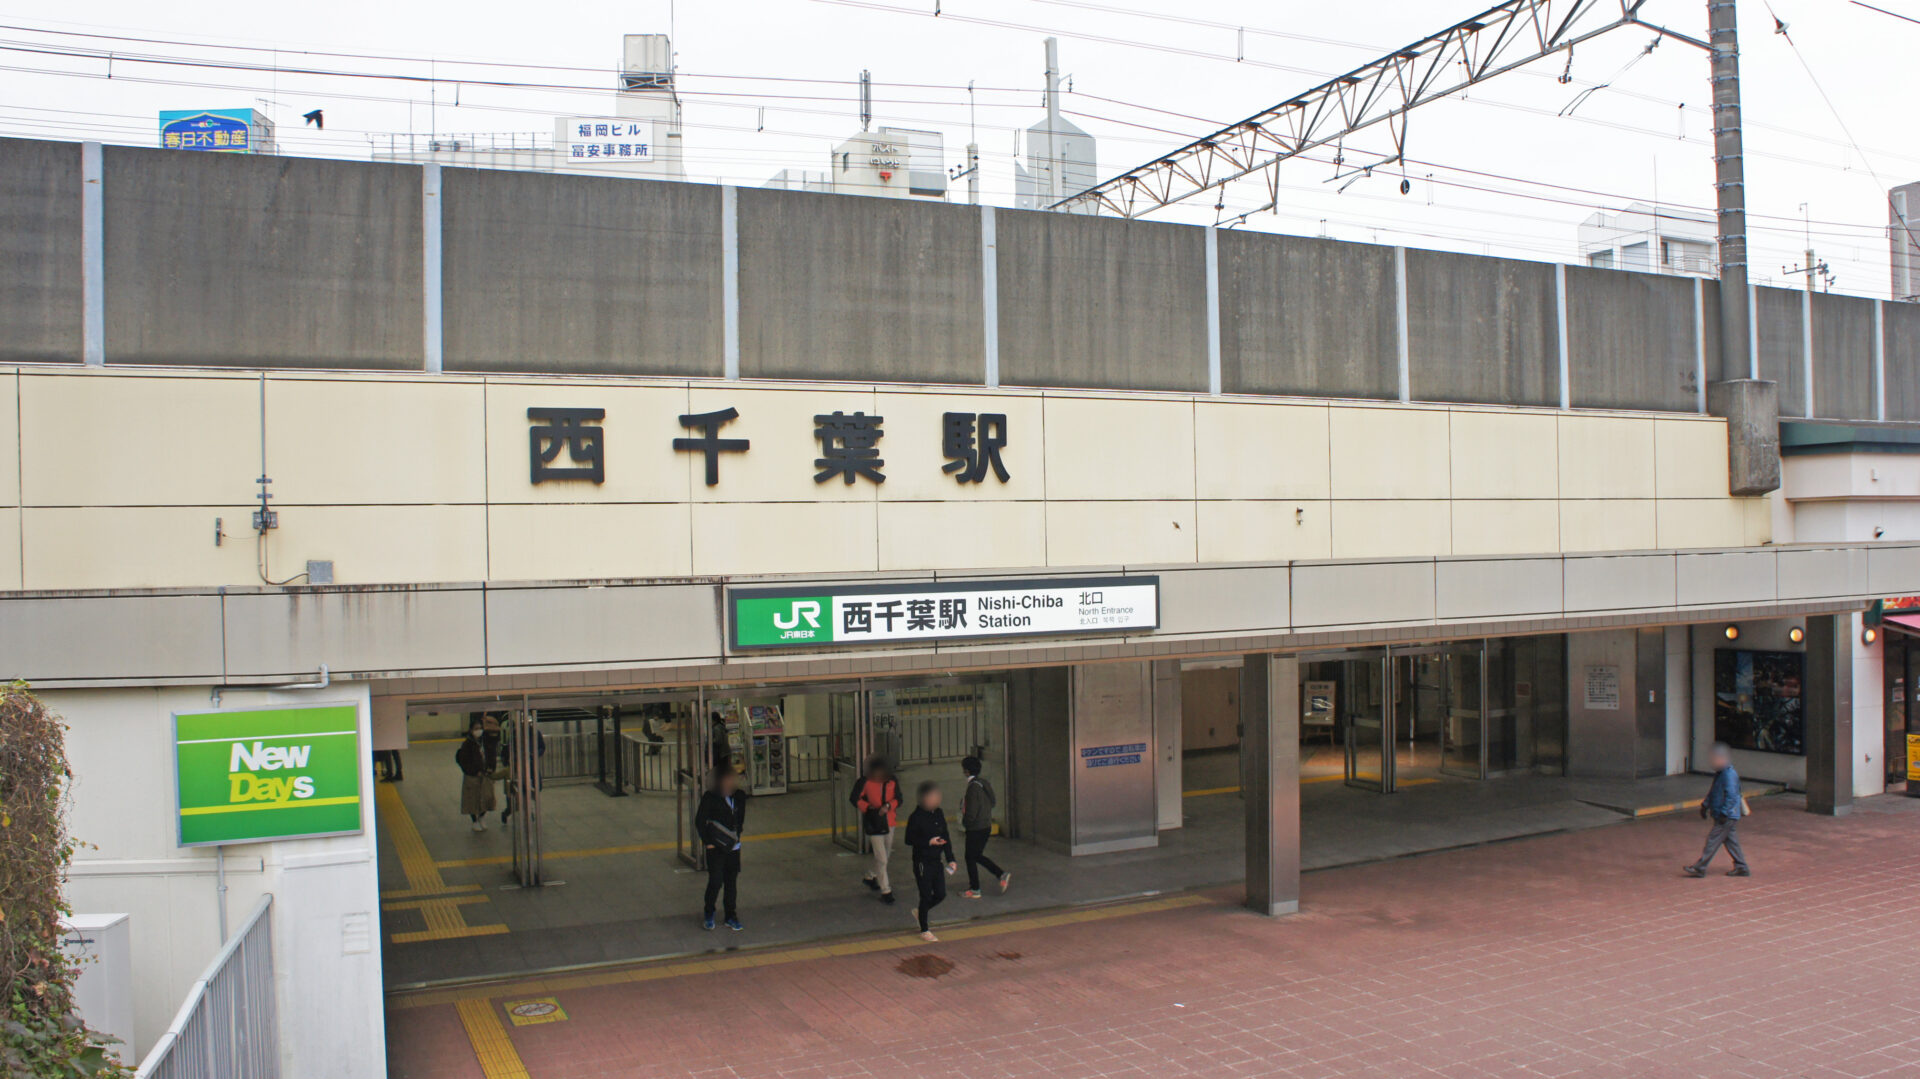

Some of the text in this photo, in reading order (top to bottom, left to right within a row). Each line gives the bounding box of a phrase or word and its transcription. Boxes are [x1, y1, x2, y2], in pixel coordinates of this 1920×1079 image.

[578, 123, 641, 137] 福岡ビル
[165, 130, 247, 148] 春日不動産
[527, 406, 1011, 486] 西千葉駅
[978, 595, 1063, 611] Nishi-Chiba
[1079, 592, 1103, 605] 北口
[774, 600, 821, 629] JR
[842, 598, 968, 634] 西千葉駅
[1079, 606, 1134, 616] North Entrance
[978, 614, 1031, 629] Station
[780, 630, 816, 640] JR東日本
[229, 741, 311, 772] New
[228, 773, 315, 802] Days
